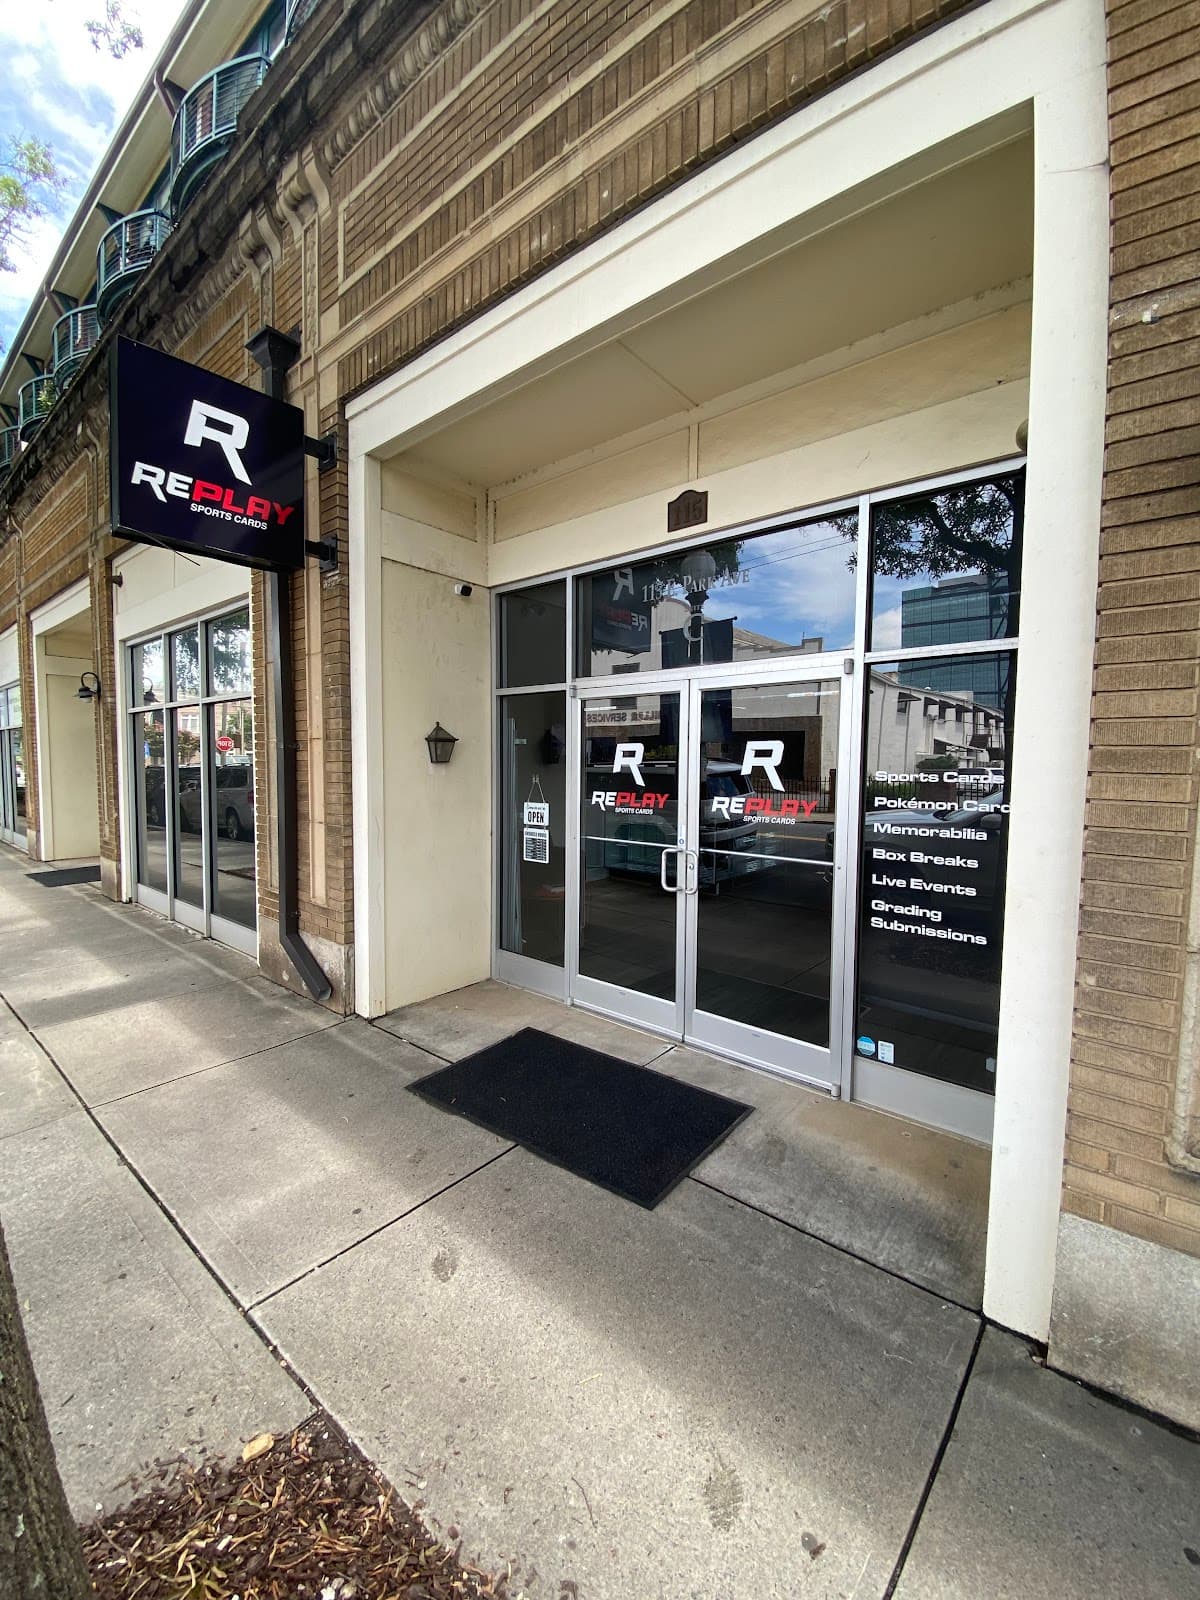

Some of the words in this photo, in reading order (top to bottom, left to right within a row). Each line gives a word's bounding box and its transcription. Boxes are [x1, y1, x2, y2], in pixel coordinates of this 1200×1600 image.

[184, 399, 252, 486] R
[131, 461, 295, 525] REPLAY
[190, 503, 232, 520] SPORTS
[234, 515, 268, 530] CARDS
[683, 575, 716, 593] PARK
[720, 566, 750, 587] AVE
[612, 743, 646, 787] R
[741, 740, 785, 792] R
[875, 770, 939, 784] Sports
[943, 771, 1005, 784] Cards
[592, 791, 670, 811] REPLAY
[711, 796, 818, 820] REPLAY
[874, 796, 959, 811] Pokémon
[528, 811, 545, 823] OPEN
[743, 815, 770, 823] SPORTS
[771, 817, 796, 825] CARDS
[873, 822, 988, 841] Memorabilia
[872, 848, 907, 862] Box
[909, 851, 979, 869] Breaks
[871, 873, 907, 888] Live
[909, 878, 977, 897] Events
[871, 900, 942, 923] Grading
[870, 917, 988, 945] Submissions
